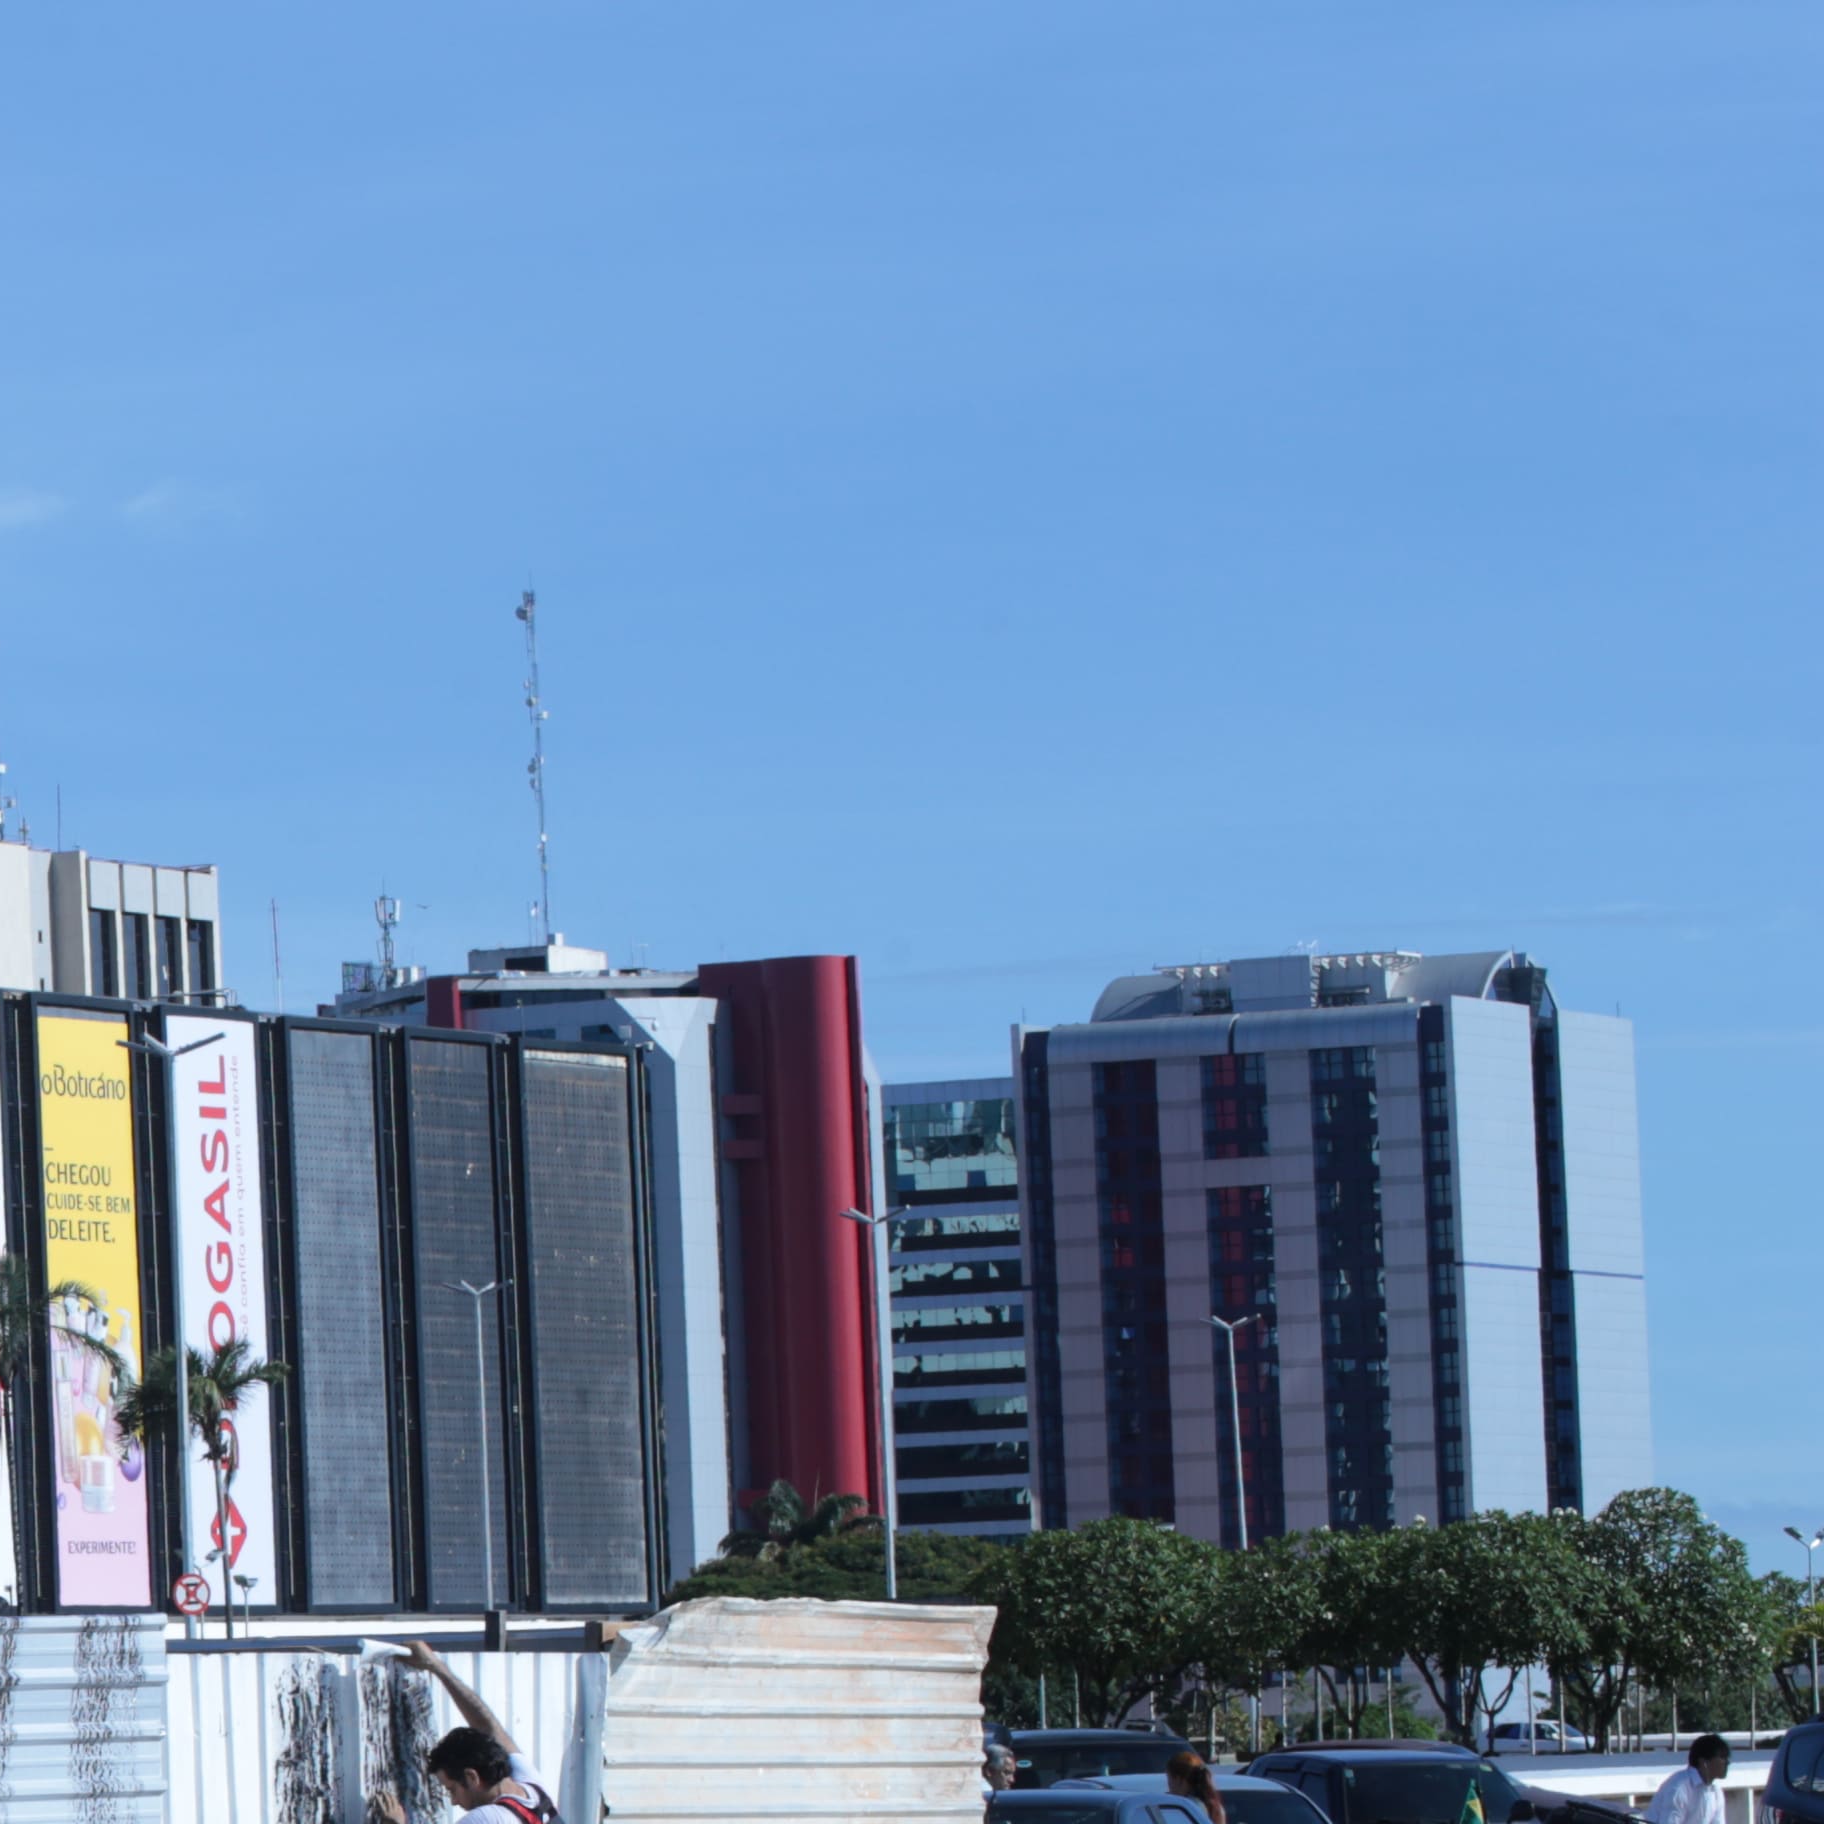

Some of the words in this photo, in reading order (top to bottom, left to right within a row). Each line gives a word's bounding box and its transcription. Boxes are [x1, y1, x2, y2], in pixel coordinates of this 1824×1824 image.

[229, 1055, 242, 1137] entende
[45, 1161, 112, 1188] CHEGOU
[233, 1144, 247, 1201] quem
[46, 1192, 103, 1213] CUIDE-SE
[106, 1196, 131, 1214] BEM
[47, 1218, 116, 1244] DELEITE.
[235, 1207, 247, 1237] em
[197, 1053, 240, 1470] DOGASIL
[67, 1539, 137, 1555] EXPERIMENTE!
